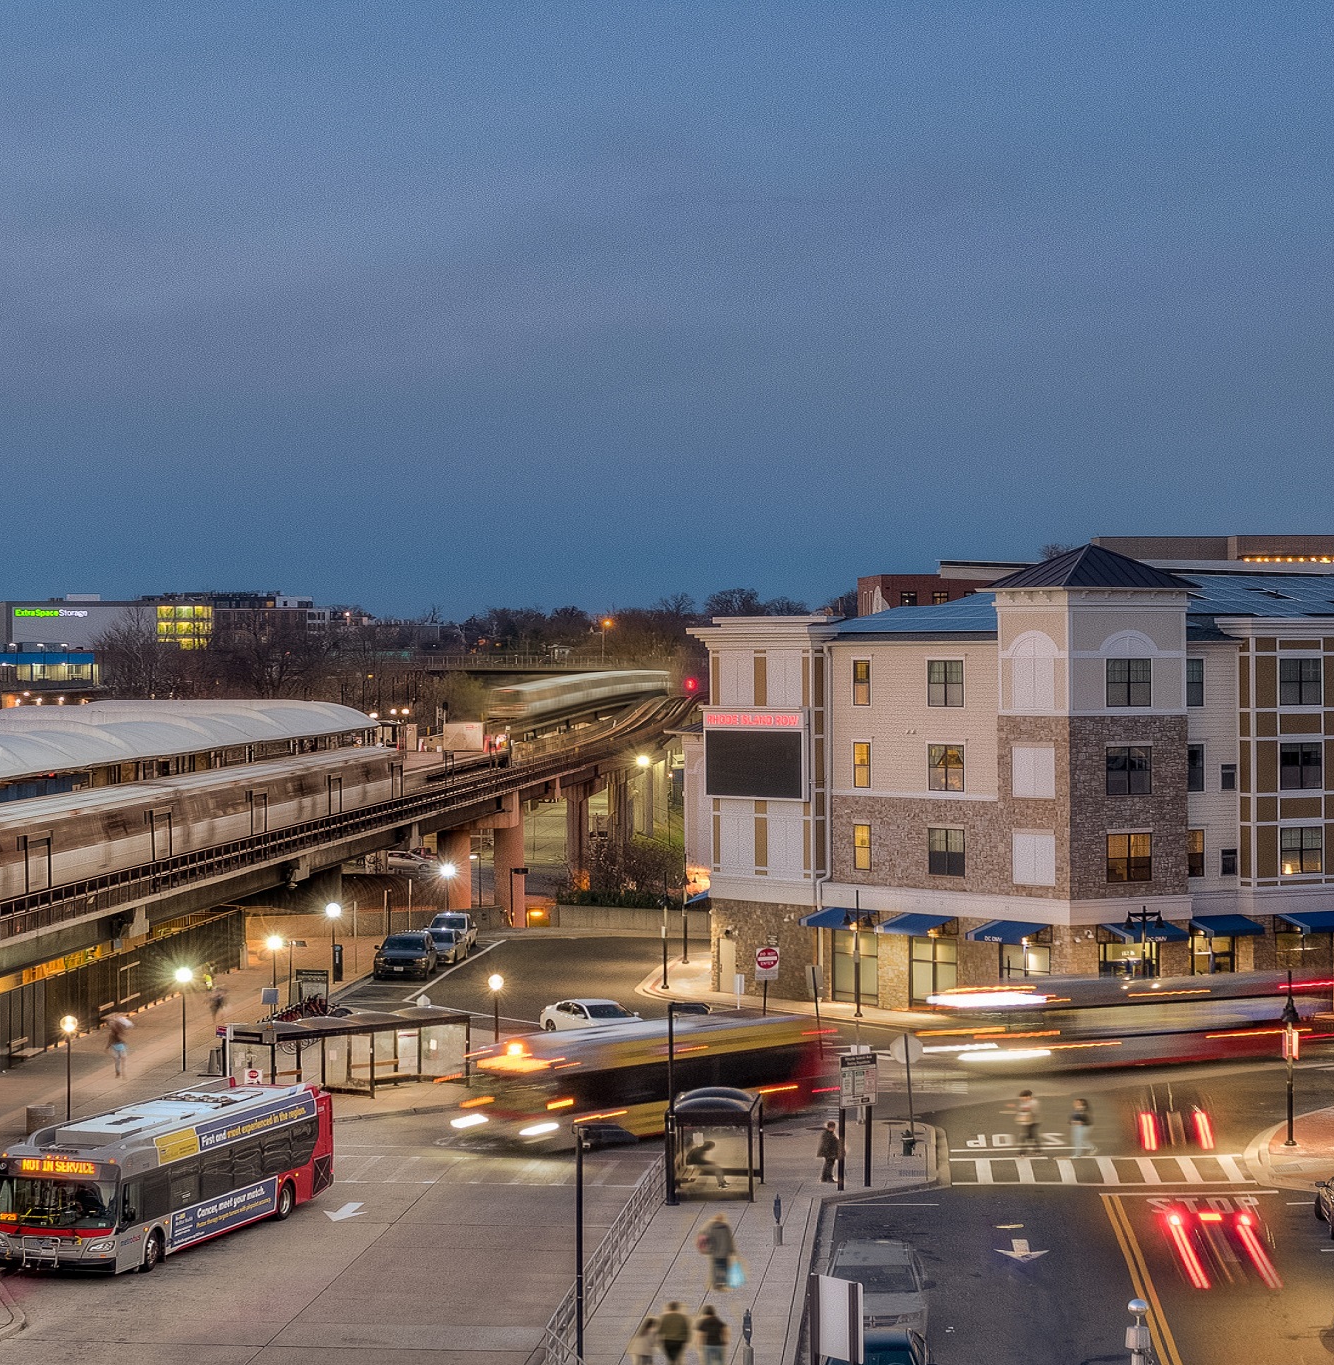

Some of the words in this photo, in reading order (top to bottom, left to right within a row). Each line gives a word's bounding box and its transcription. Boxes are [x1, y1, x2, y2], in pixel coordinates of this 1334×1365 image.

[707, 714, 739, 725] RHODE
[740, 714, 774, 726] ISLAND
[775, 715, 799, 726] ROW
[201, 1133, 216, 1147] First
[216, 1130, 227, 1142] and
[227, 1126, 241, 1138] most
[242, 1115, 273, 1134] experienced
[273, 1113, 279, 1123] in
[279, 1111, 288, 1122] the
[288, 1106, 307, 1119] region.
[22, 1159, 41, 1171] NOT
[42, 1160, 54, 1171] IN
[54, 1160, 95, 1174] SERVICE
[197, 1204, 218, 1218] Cancer,
[218, 1197, 233, 1211] meet
[233, 1194, 247, 1207] your
[247, 1185, 266, 1200] match.
[1146, 1196, 1260, 1214] STOP
